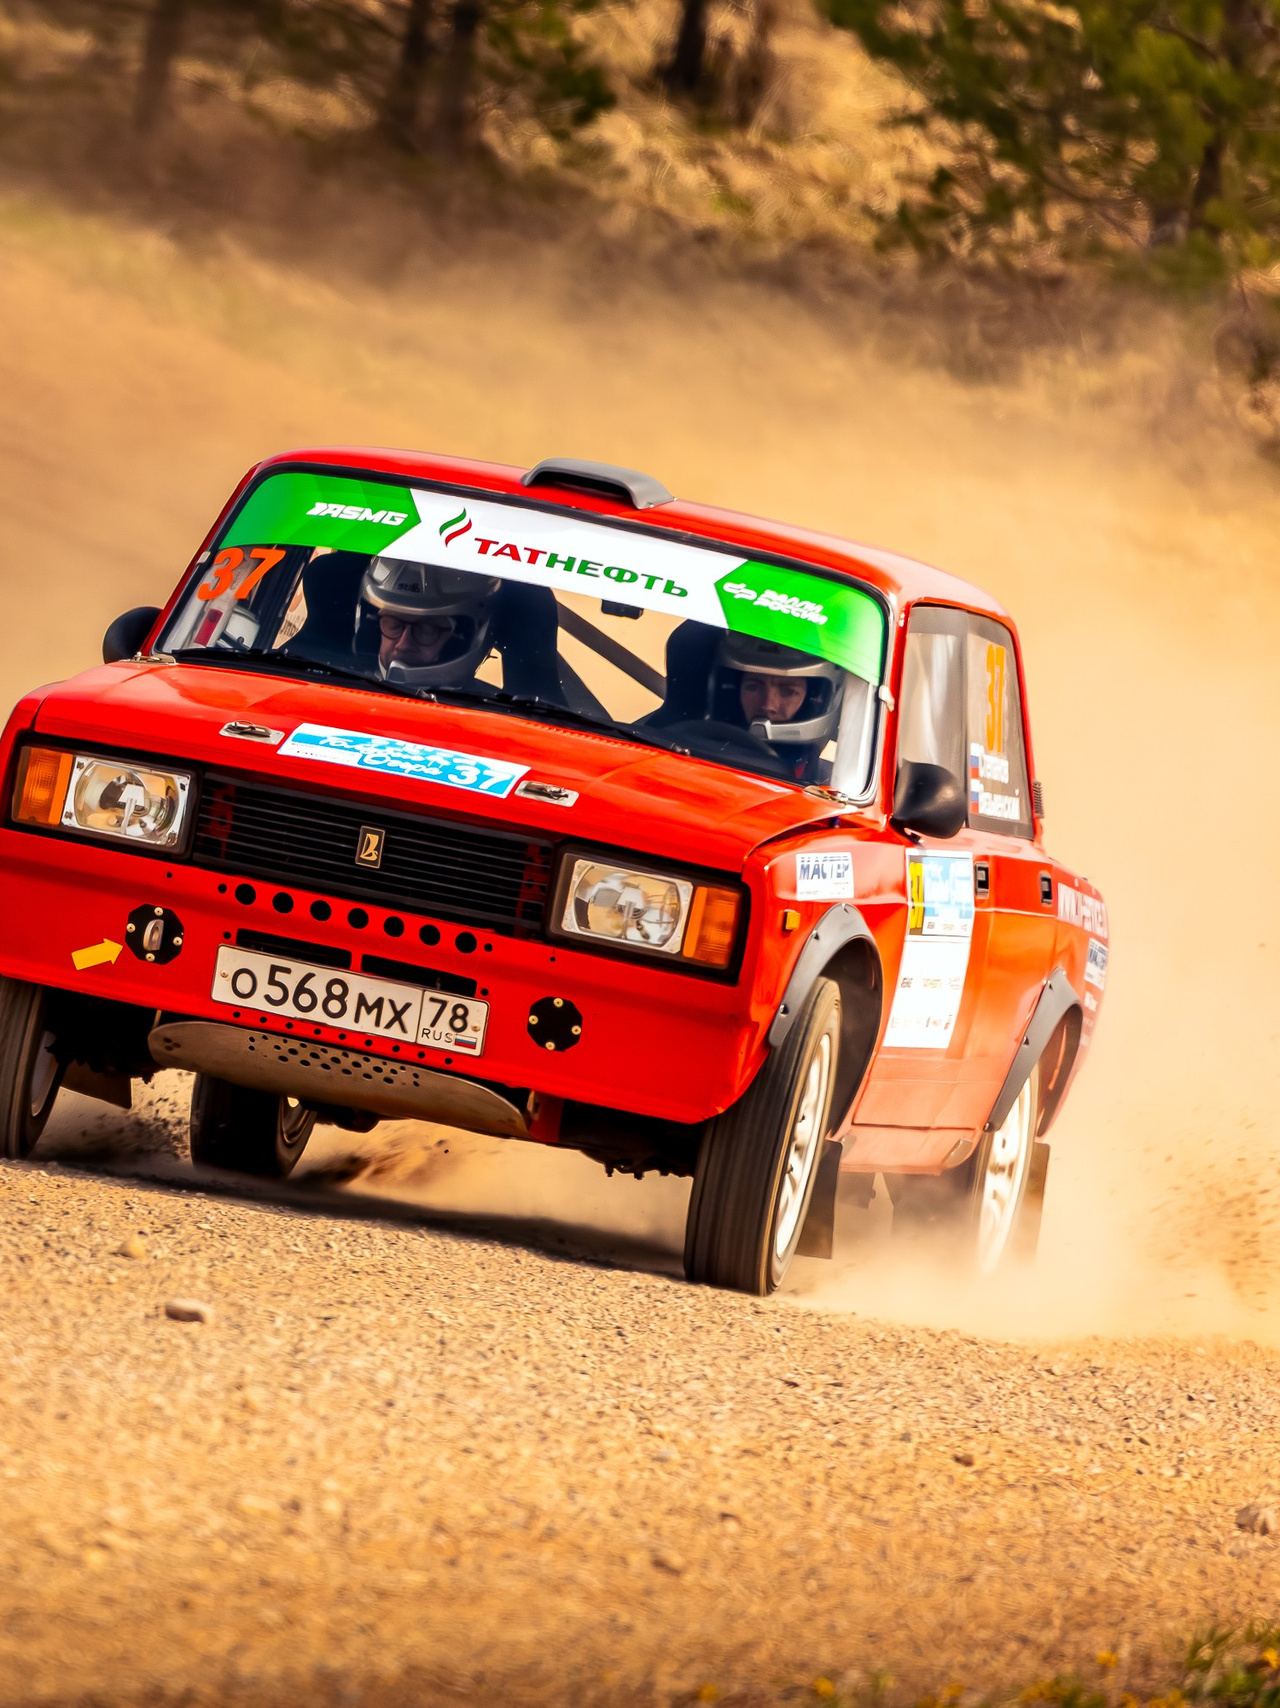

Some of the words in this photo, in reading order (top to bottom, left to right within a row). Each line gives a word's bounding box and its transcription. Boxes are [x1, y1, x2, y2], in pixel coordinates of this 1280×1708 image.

[196, 547, 287, 601] 37
[474, 537, 688, 597] ТАТНЕФТЬ
[447, 764, 512, 790] 37
[428, 997, 470, 1033] 78
[421, 1027, 454, 1044] RUS
